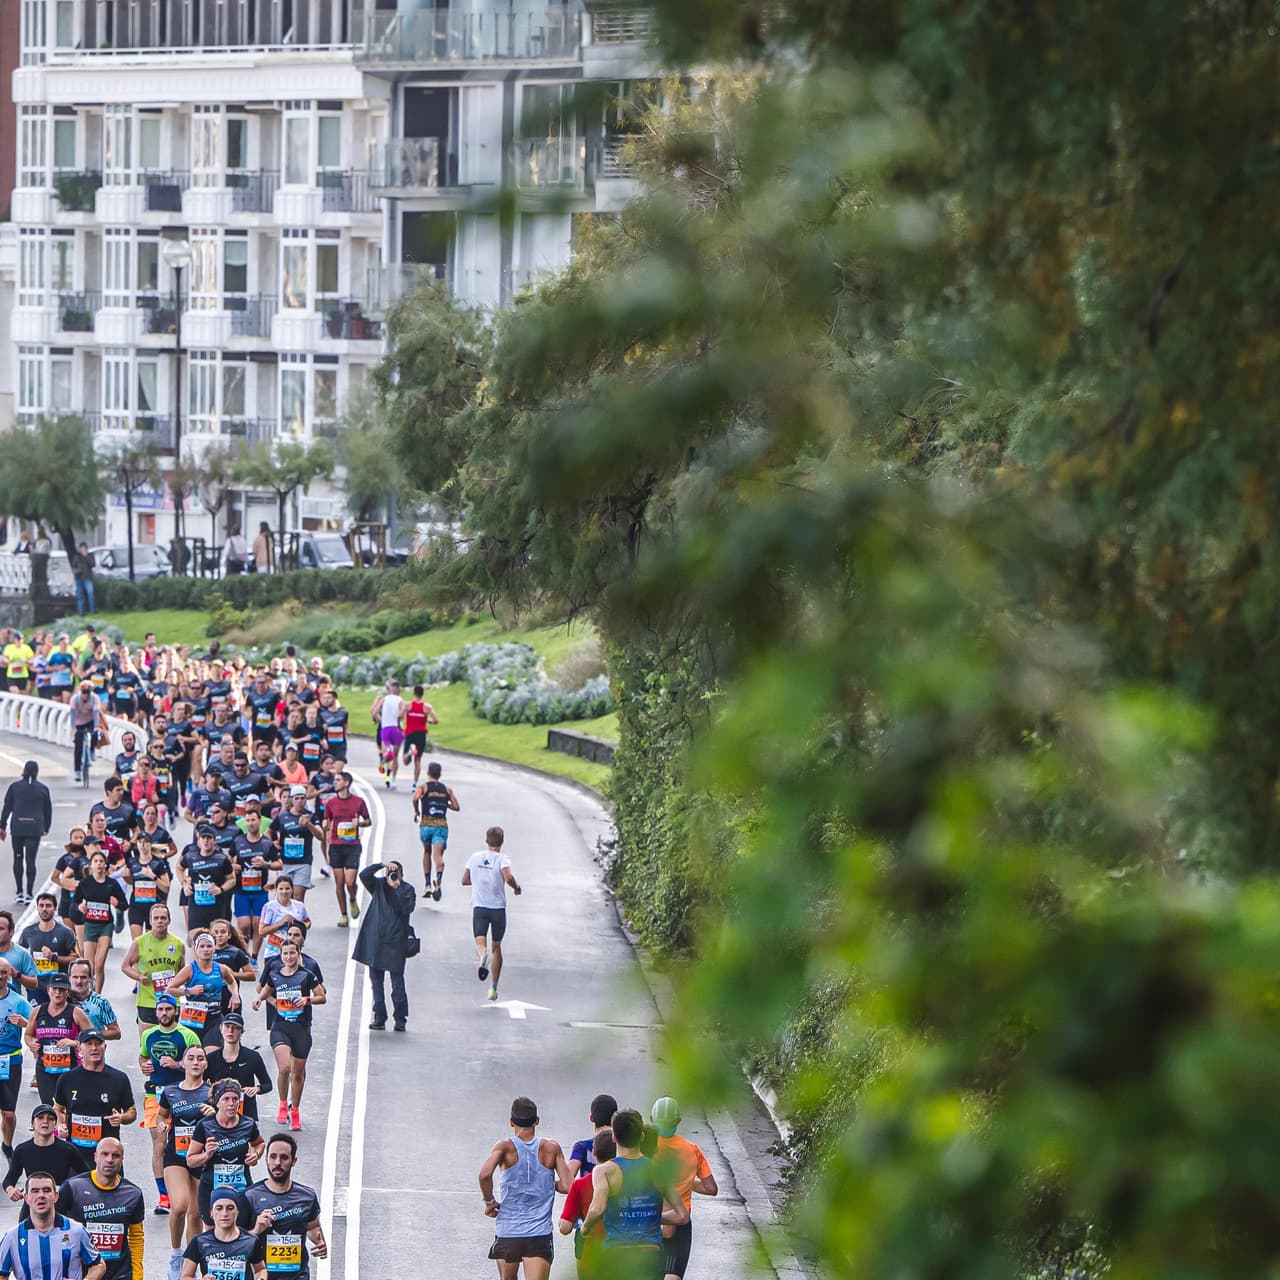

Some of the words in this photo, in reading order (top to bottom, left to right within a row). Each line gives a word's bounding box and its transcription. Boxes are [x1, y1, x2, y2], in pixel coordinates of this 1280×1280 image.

[217, 1174, 243, 1184] 5375
[83, 1203, 105, 1213] SALTO
[84, 1206, 126, 1220] FOUNDATION
[91, 1234, 119, 1246] 3133
[270, 1246, 299, 1257] 2234
